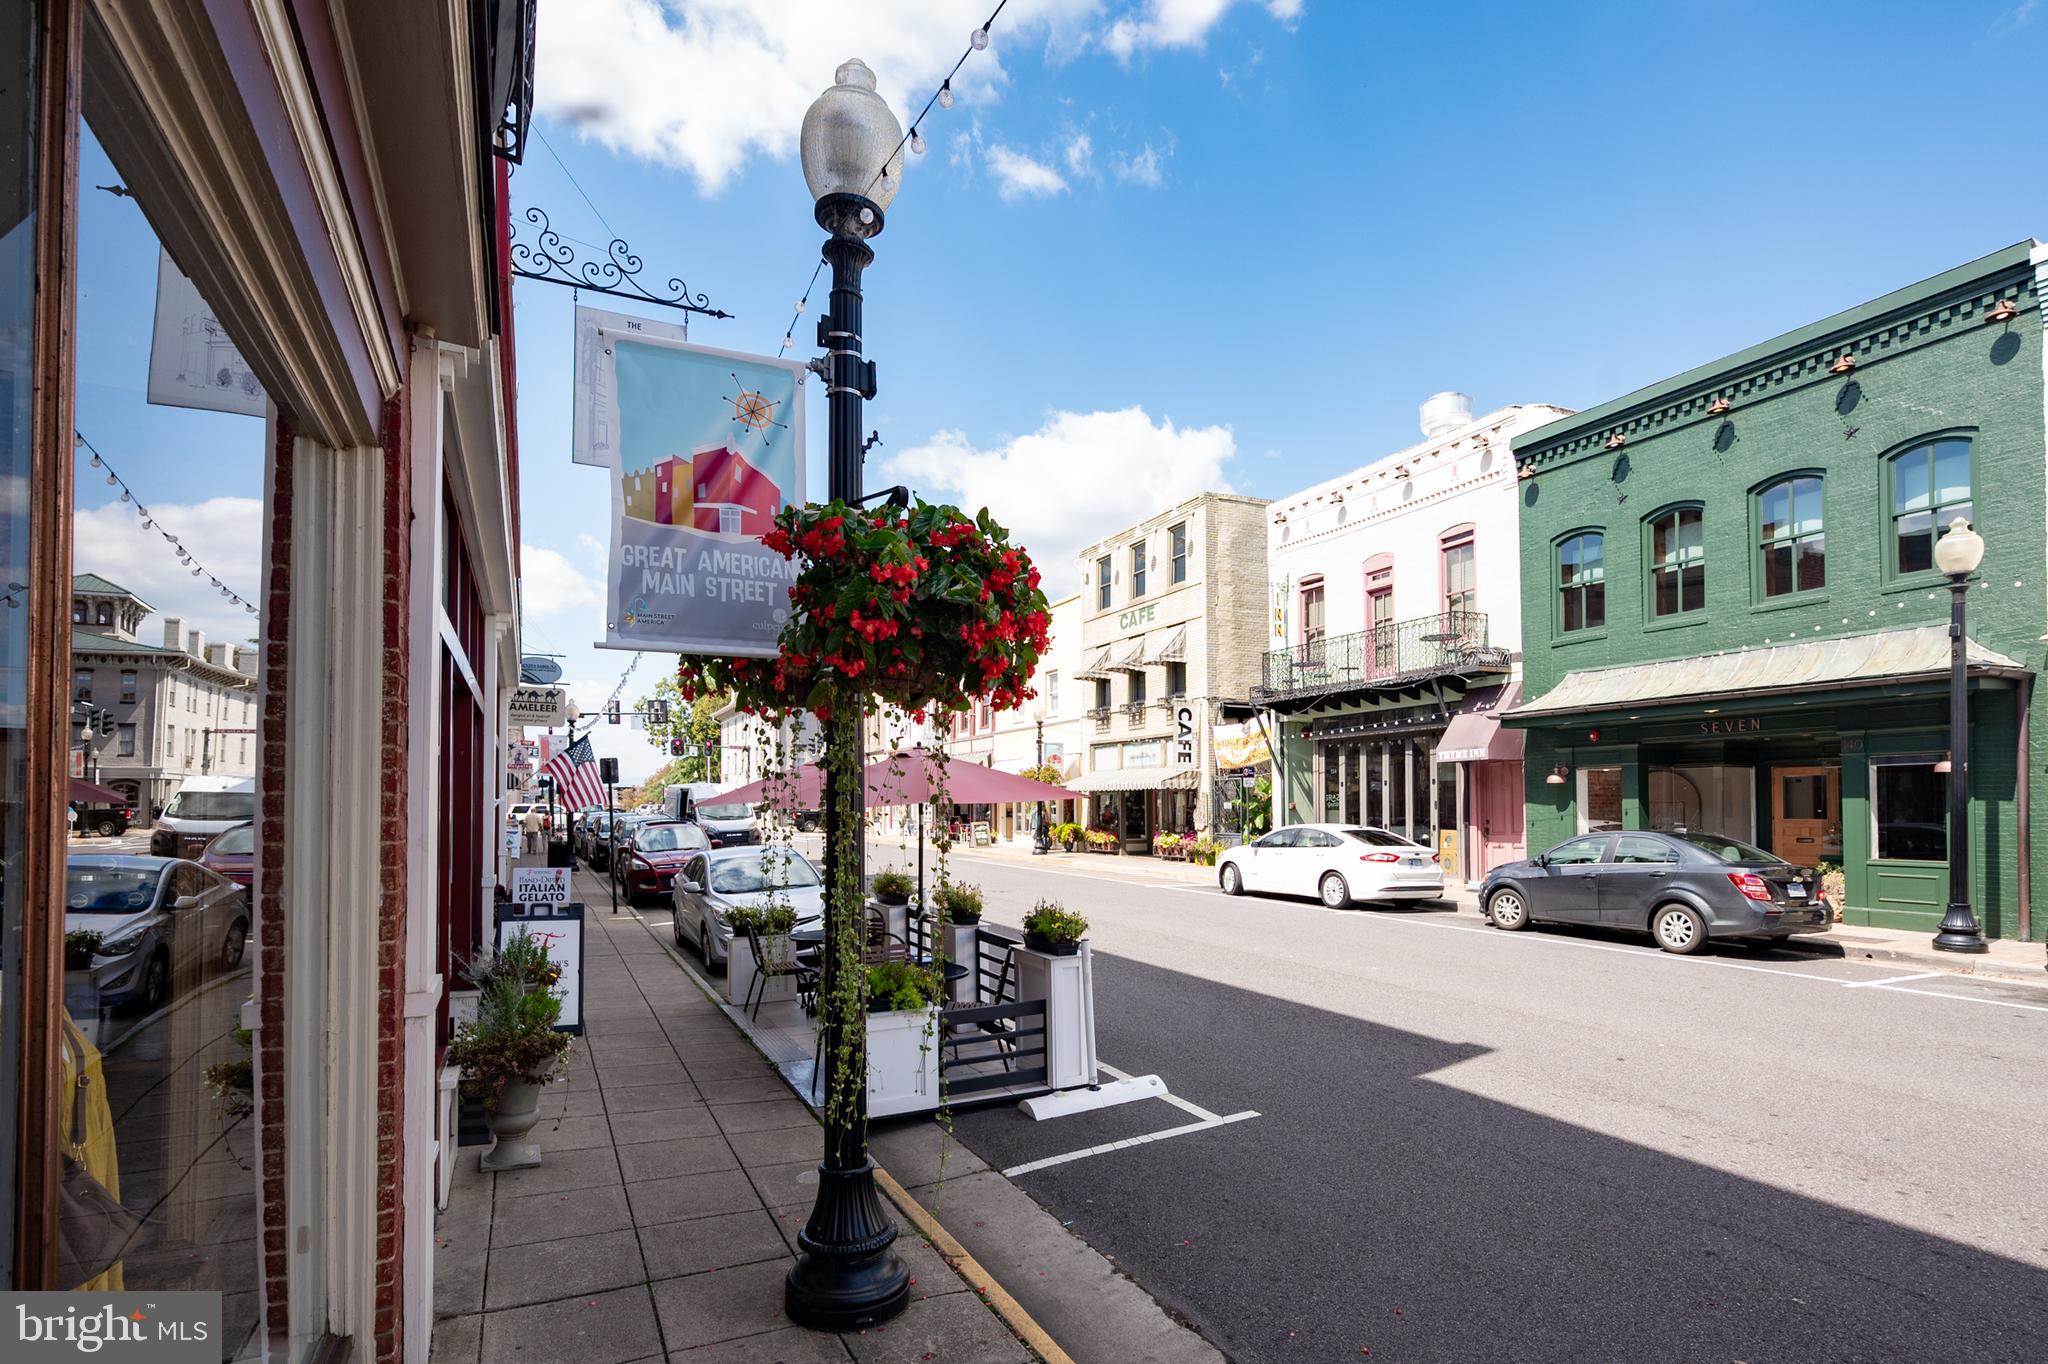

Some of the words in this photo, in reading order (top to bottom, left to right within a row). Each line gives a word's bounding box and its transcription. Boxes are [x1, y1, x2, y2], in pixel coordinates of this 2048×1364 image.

[626, 321, 642, 331] THE
[621, 544, 687, 573] GREAT
[698, 549, 797, 581] AMERICAN
[642, 569, 695, 597] MAIN
[706, 576, 778, 606] STREET
[1119, 605, 1155, 629] CAFE
[752, 620, 784, 634] culpep
[509, 703, 557, 713] AMELEER
[1700, 719, 1760, 734] SEVEN
[1178, 708, 1192, 763] CAFE
[1469, 748, 1485, 758] INN
[519, 883, 565, 893] ITALIAN
[519, 893, 565, 902] GELATO
